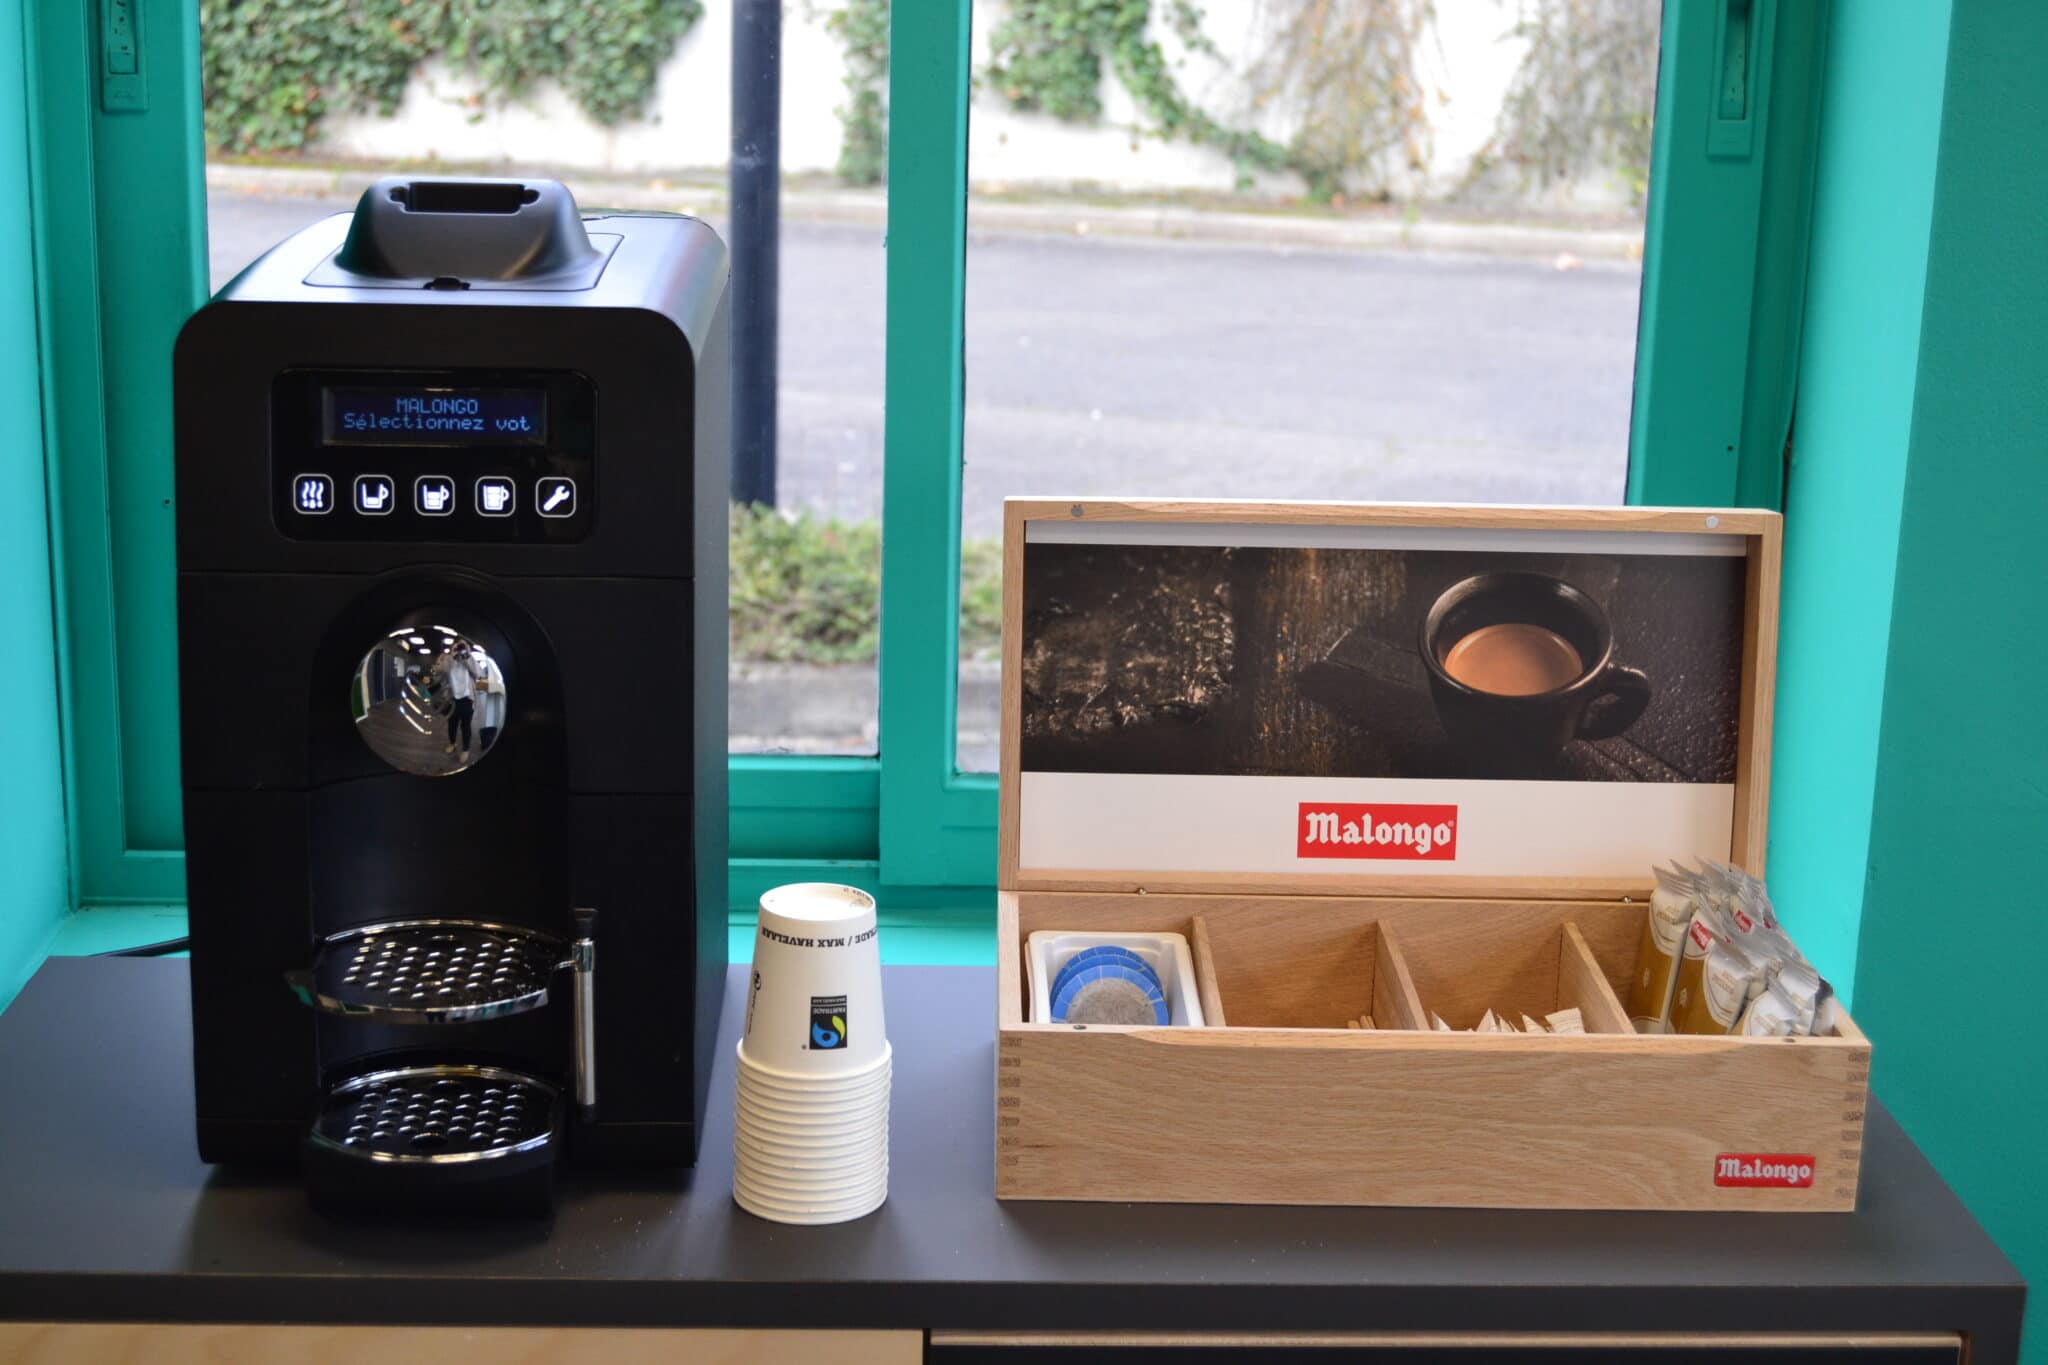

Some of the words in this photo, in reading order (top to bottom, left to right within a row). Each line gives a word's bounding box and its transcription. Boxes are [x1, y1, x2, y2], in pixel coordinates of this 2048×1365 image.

[396, 398, 479, 414] MALONGO
[344, 413, 485, 430] Sélectionnez
[496, 416, 531, 432] vot
[1305, 812, 1452, 855] Malongo
[817, 937, 845, 948] MAX
[1718, 1158, 1811, 1184] Malongo
